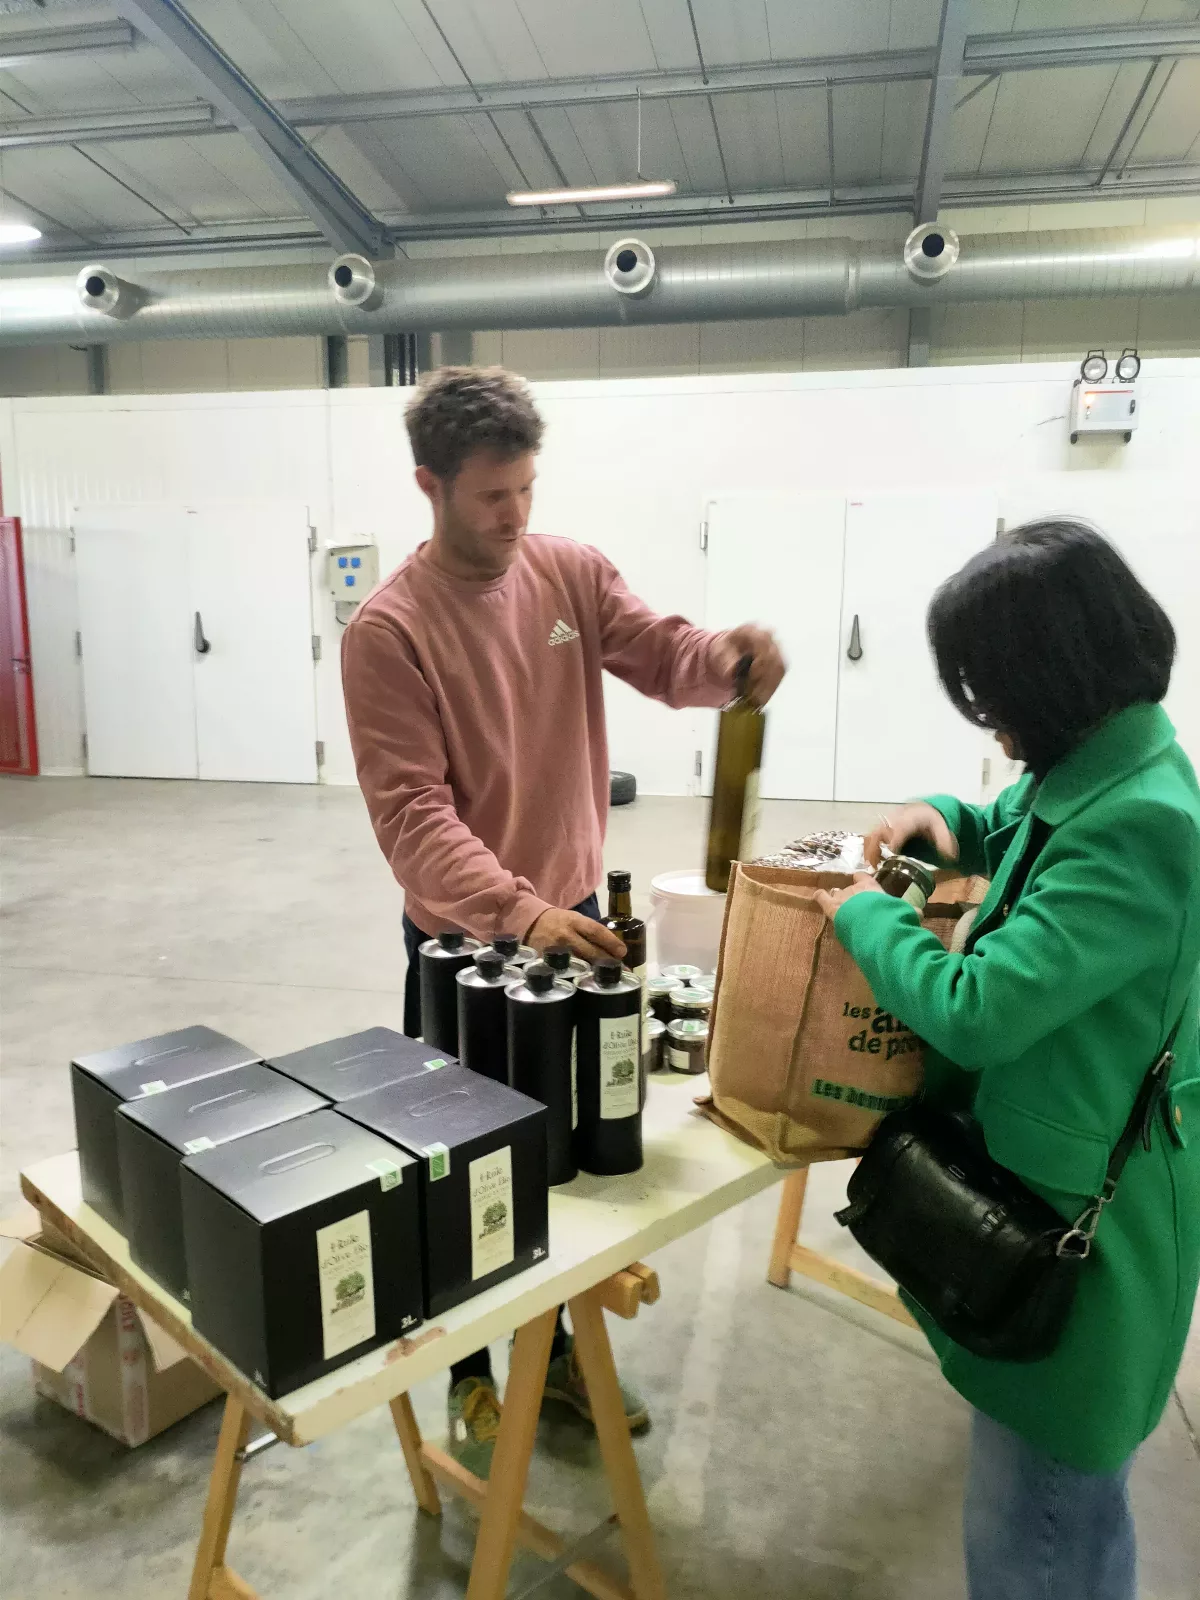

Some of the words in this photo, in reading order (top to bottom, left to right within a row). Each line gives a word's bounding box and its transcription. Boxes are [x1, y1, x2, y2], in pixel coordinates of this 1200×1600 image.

[547, 630, 580, 646] adidas
[842, 1001, 872, 1019] les
[848, 1029, 881, 1054] de
